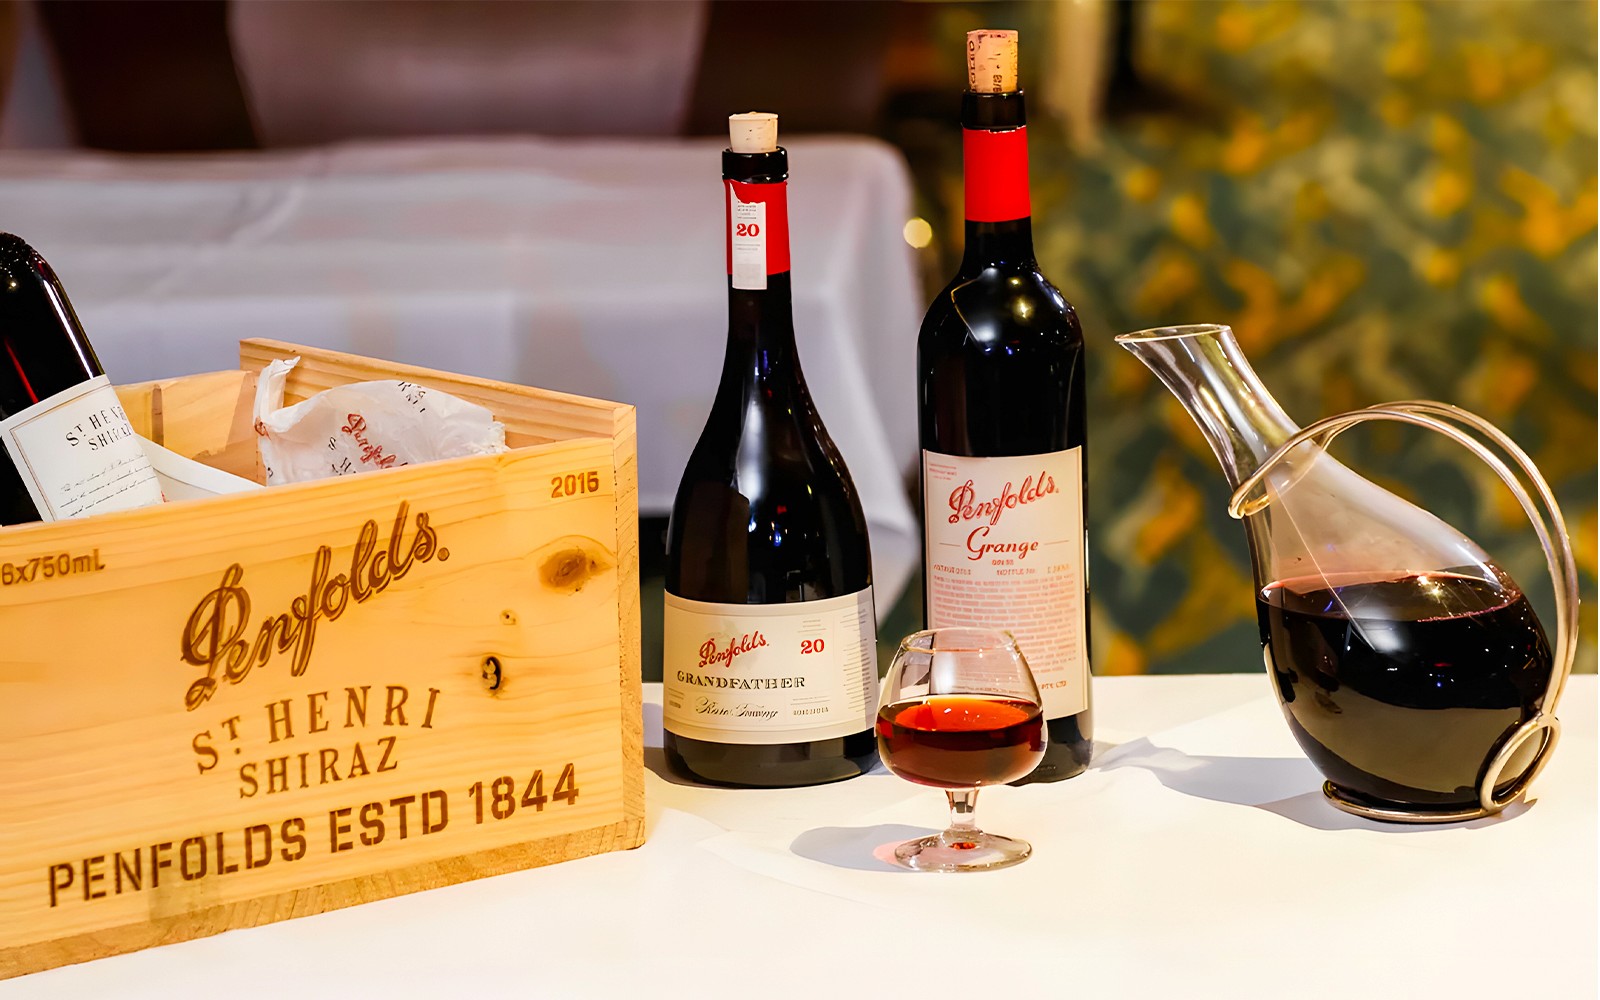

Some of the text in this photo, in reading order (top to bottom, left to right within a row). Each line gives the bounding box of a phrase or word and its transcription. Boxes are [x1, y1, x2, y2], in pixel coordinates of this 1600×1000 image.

[736, 223, 760, 237] 20
[966, 526, 1038, 560] Grange
[1, 549, 105, 586] 6x750mL
[800, 639, 825, 655] 20
[677, 670, 806, 690] GRANDFATHER
[264, 685, 440, 743] HENRI
[239, 736, 398, 798] SHIRAZ
[48, 762, 580, 906] PENFOLDS ESTD 1844
